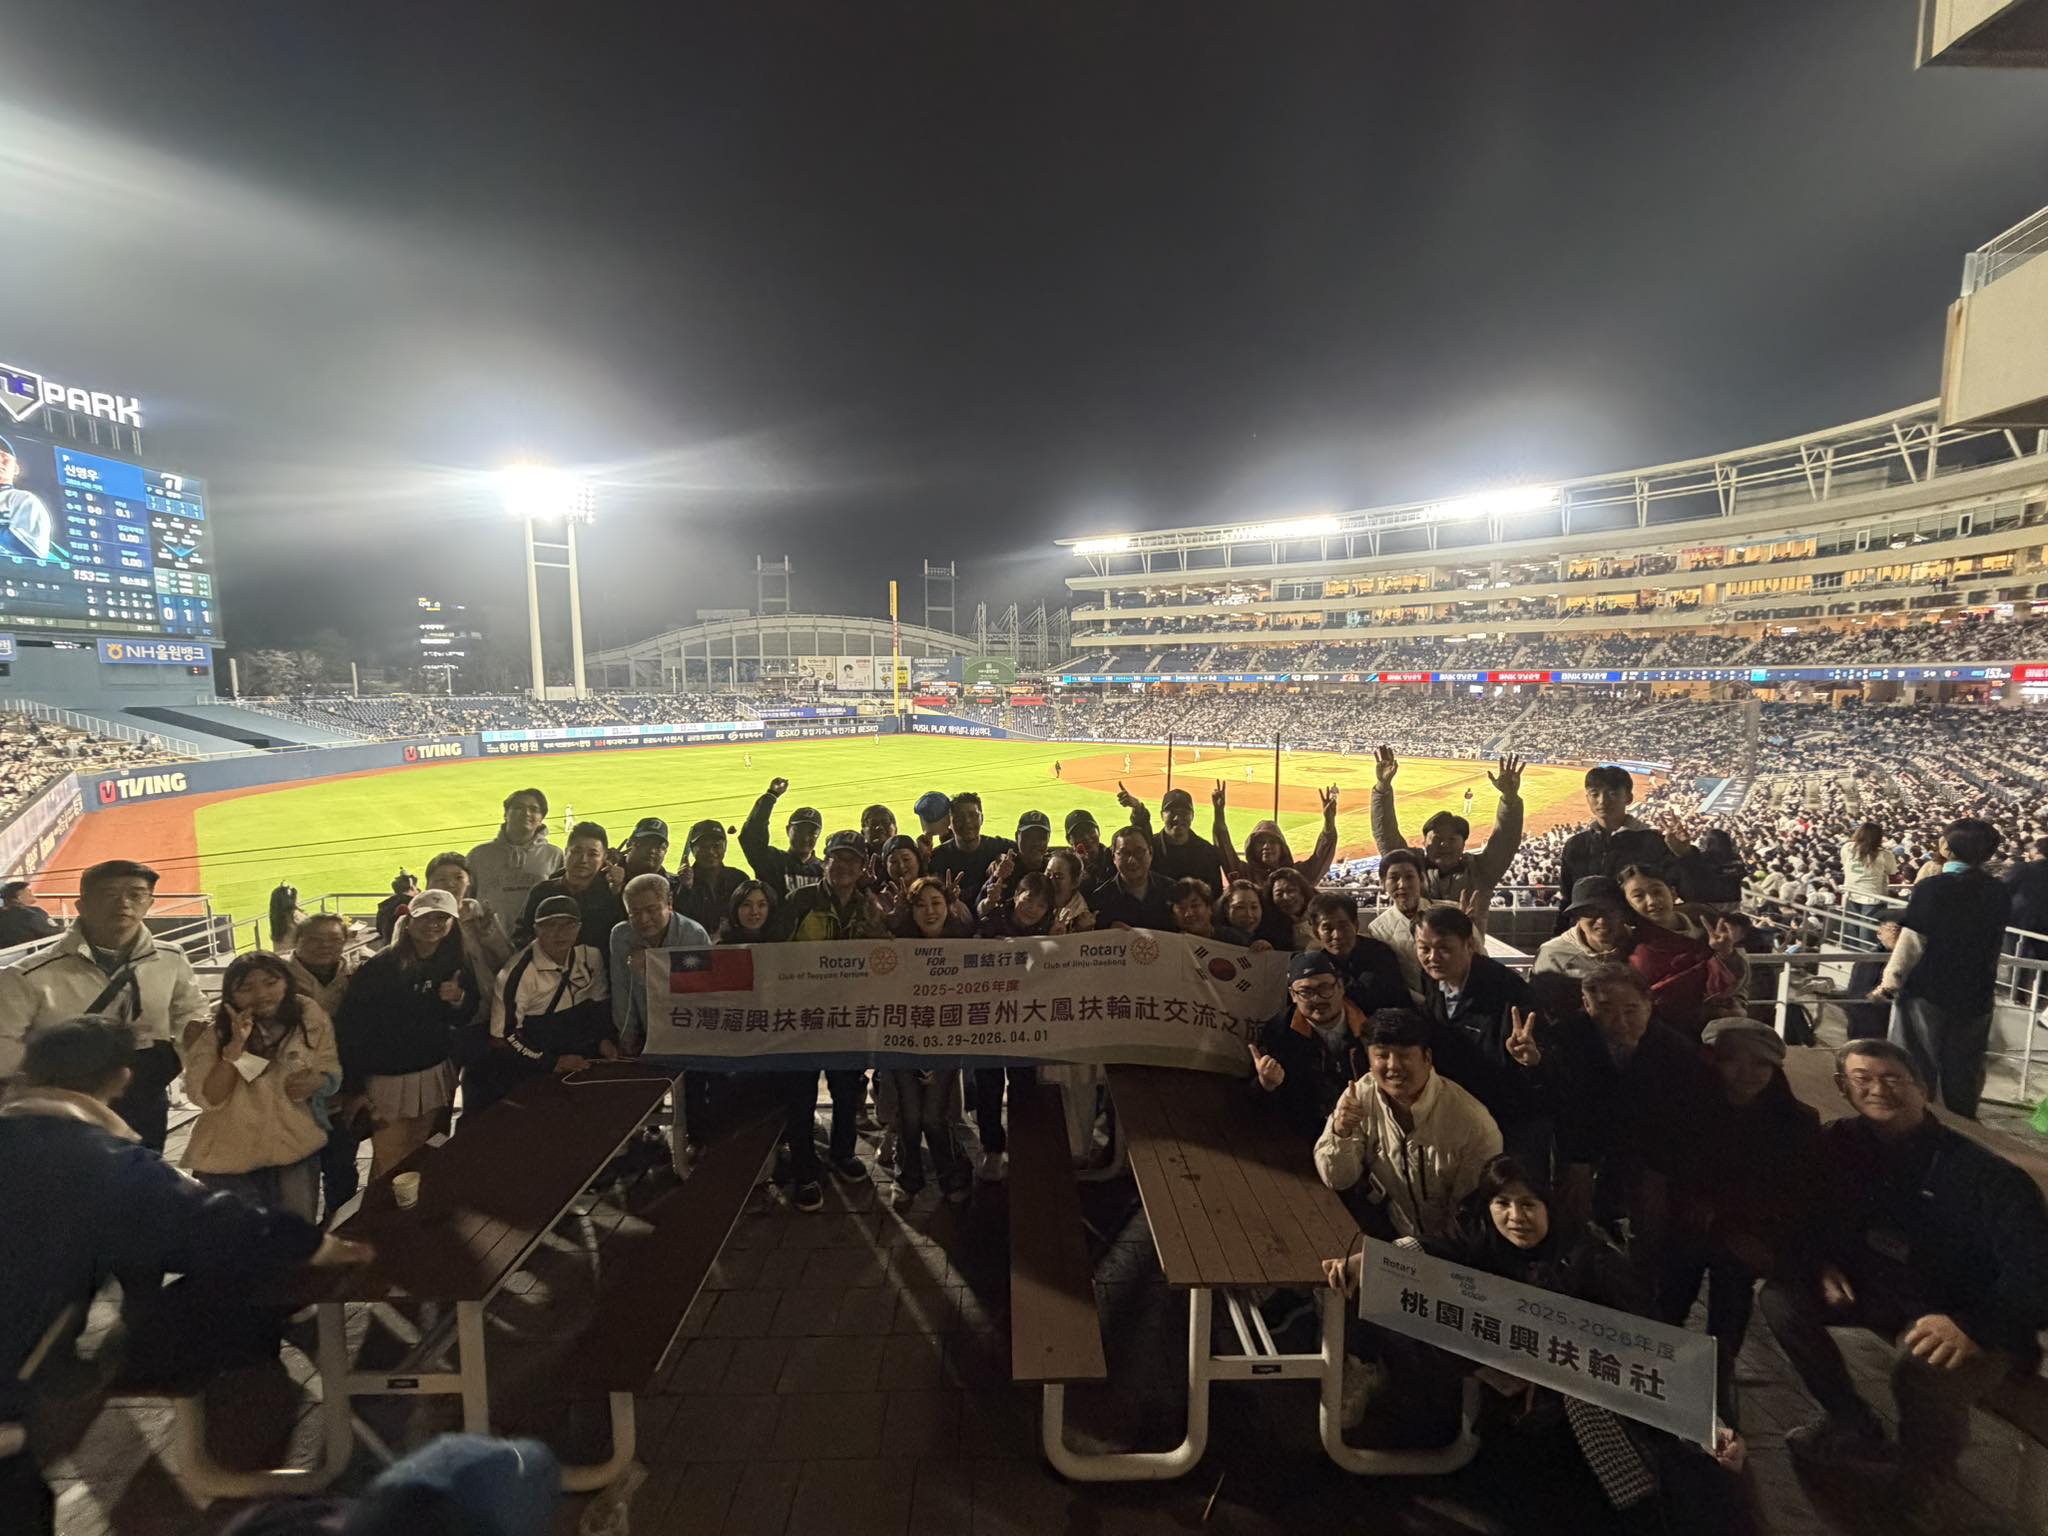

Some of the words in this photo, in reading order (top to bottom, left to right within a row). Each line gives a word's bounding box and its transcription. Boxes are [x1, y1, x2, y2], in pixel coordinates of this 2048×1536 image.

[43, 382, 142, 428] PARK
[73, 569, 95, 582] 153
[164, 607, 174, 620] 0
[184, 609, 192, 622] 1
[202, 611, 210, 623] 1
[126, 643, 206, 661] NH올원뱅크
[1985, 668, 2002, 679] 153
[775, 729, 800, 738] BESKO
[418, 742, 462, 760] TVING
[117, 772, 187, 800] TVING
[914, 947, 945, 956] UNITE
[1080, 944, 1127, 957] Rotary
[819, 955, 866, 970] Rotary
[926, 956, 946, 966] FOR
[929, 966, 959, 976] GOOD
[912, 980, 1021, 996] 2025-2026年度
[1383, 1257, 1417, 1276] Rotary
[1516, 1298, 1678, 1362] 2025-2026年度
[1400, 1286, 1667, 1401] 桃園福興扶輪社
